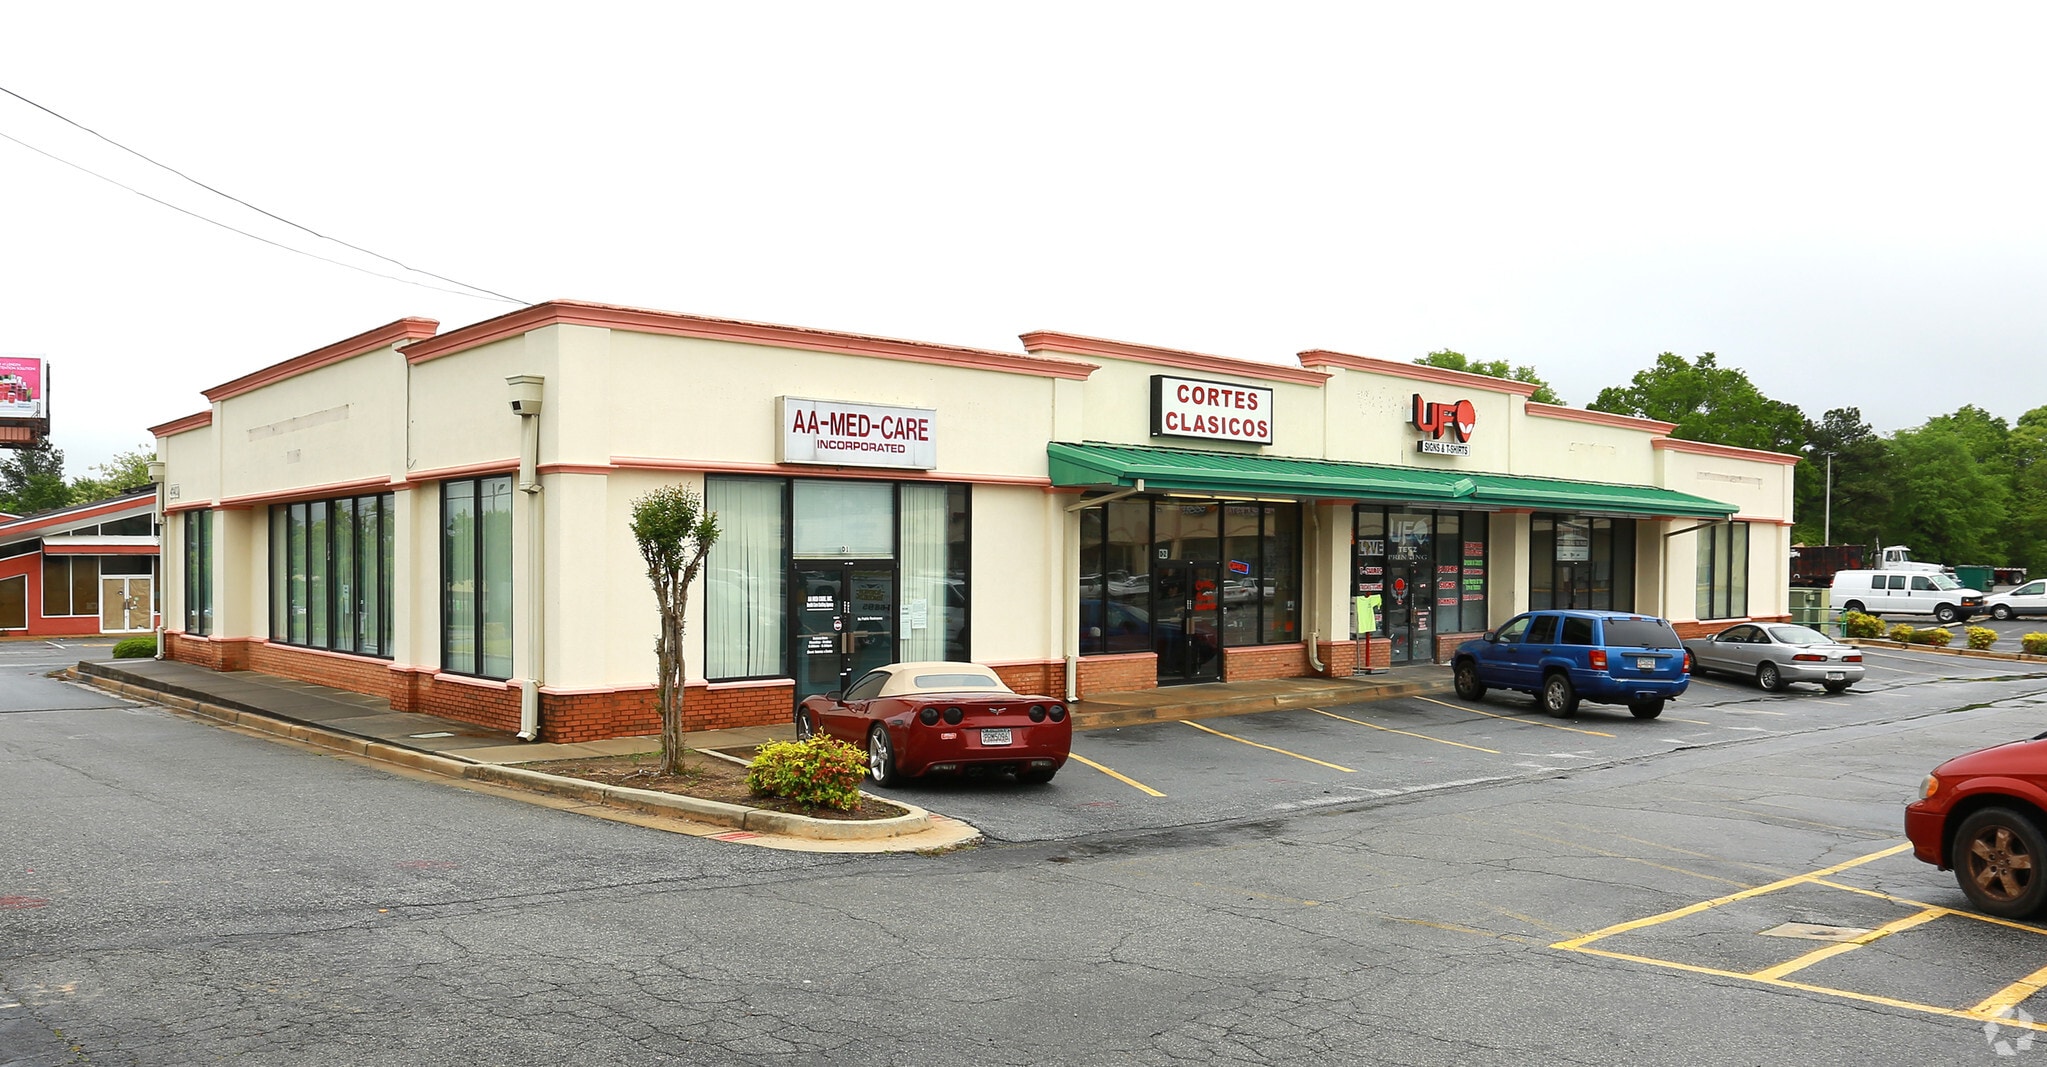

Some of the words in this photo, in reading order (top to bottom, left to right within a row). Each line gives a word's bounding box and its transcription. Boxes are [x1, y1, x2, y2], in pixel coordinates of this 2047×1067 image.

[1177, 384, 1258, 411] CORTES
[793, 409, 929, 441] AA-MED-CARE
[1165, 411, 1268, 438] CLASICOS
[1412, 393, 1476, 443] UFO
[817, 439, 906, 454] INCORPORATED
[1424, 442, 1440, 452] SIGNS
[1446, 444, 1468, 455] T-SHIRTS
[1390, 517, 1428, 545] UFO
